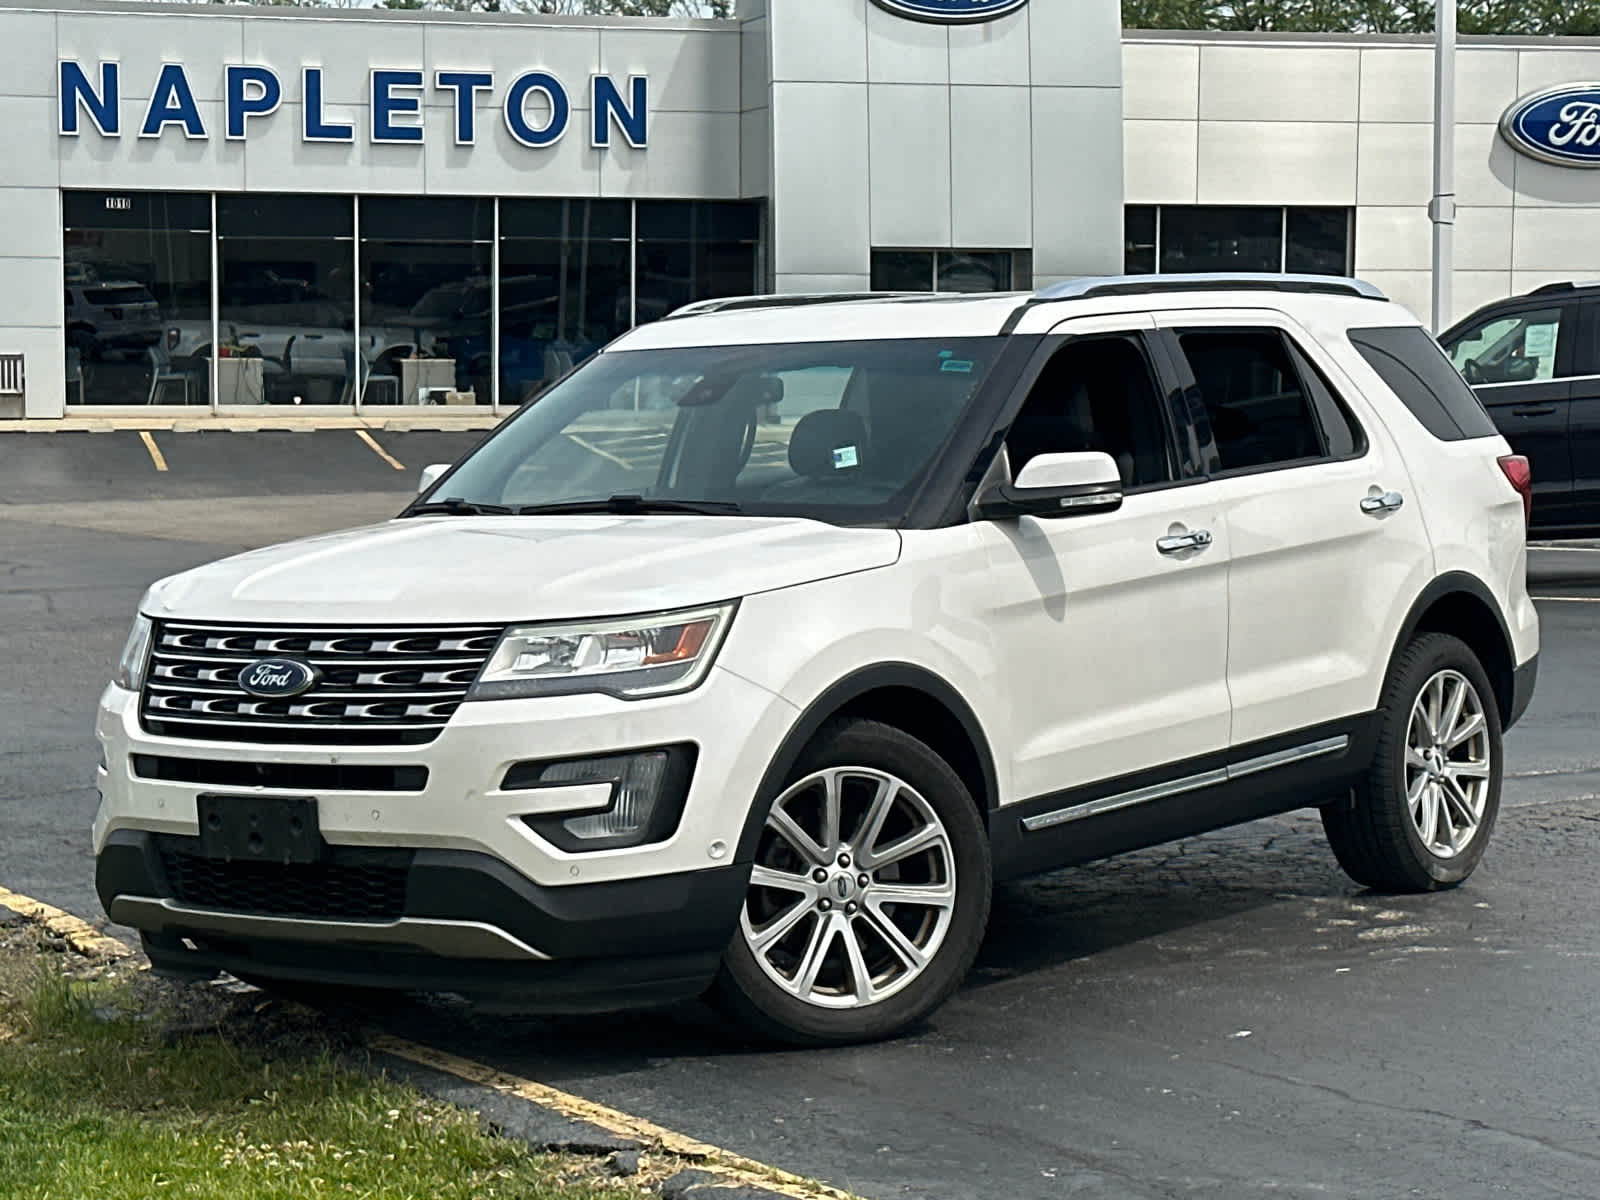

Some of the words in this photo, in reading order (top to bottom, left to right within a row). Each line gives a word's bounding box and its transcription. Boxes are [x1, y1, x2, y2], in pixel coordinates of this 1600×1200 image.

[57, 59, 649, 149] NAPLETON
[1548, 101, 1600, 146] Fo
[249, 663, 293, 687] Ford
